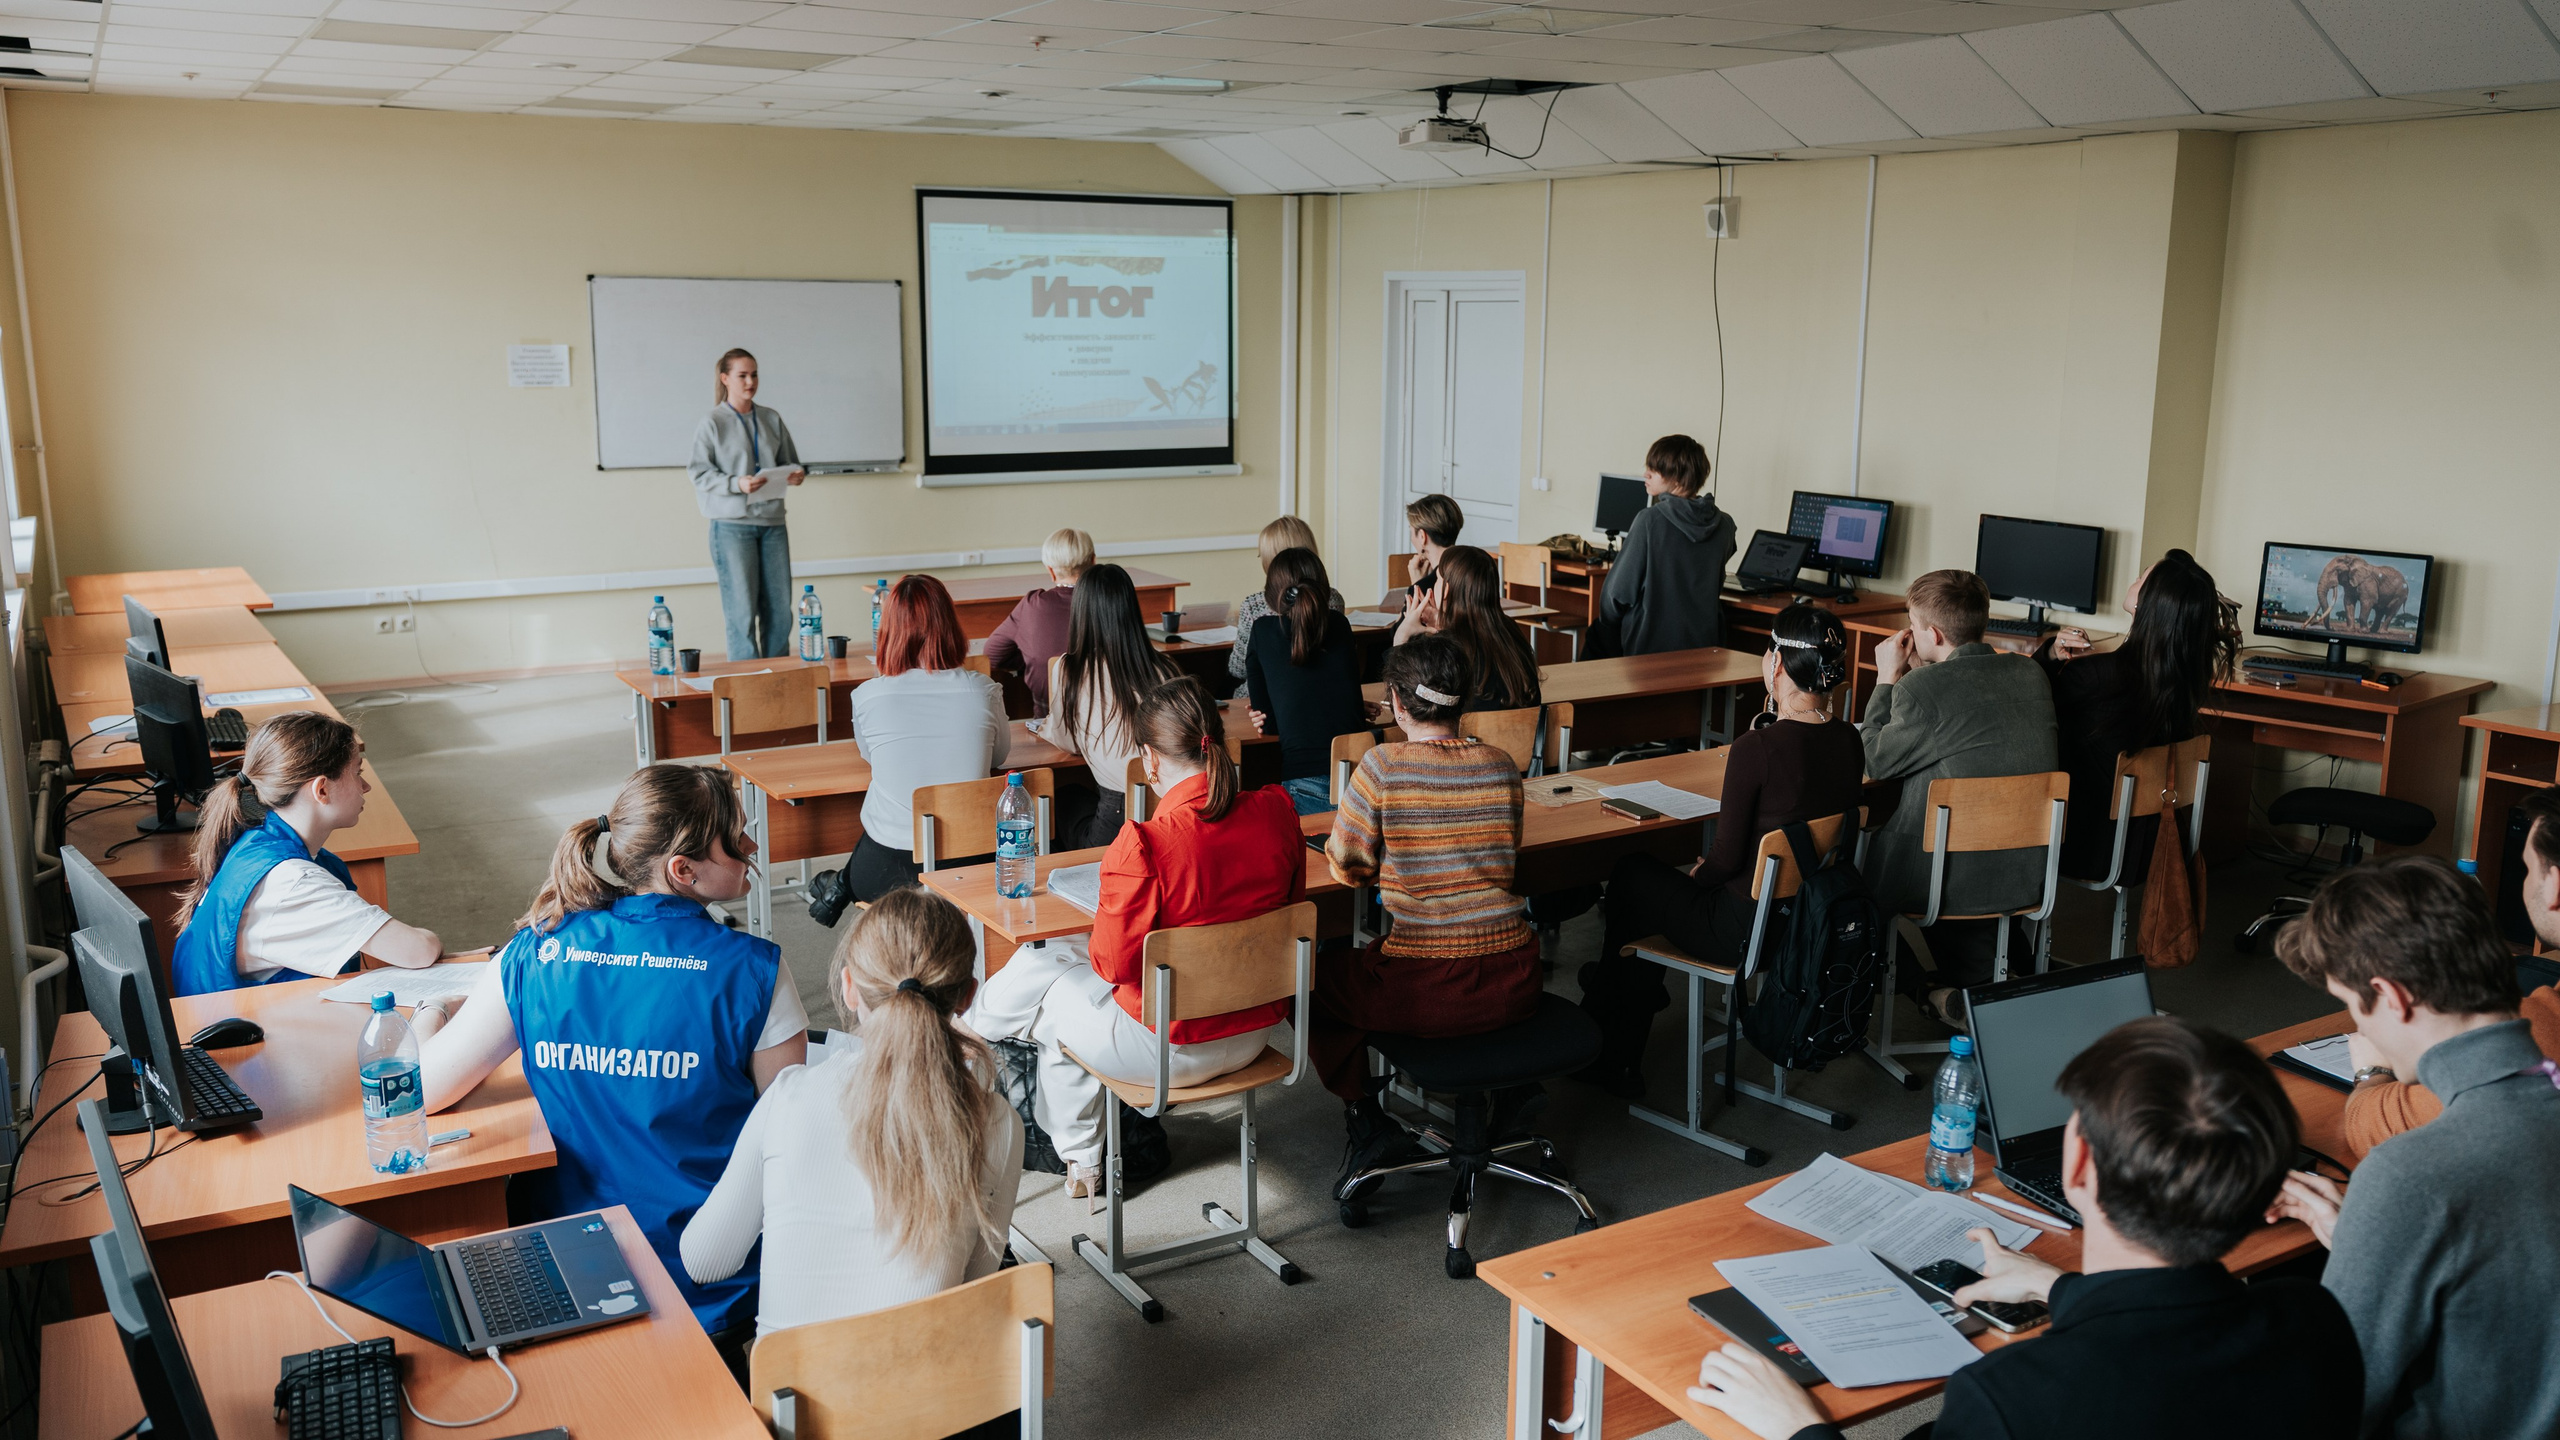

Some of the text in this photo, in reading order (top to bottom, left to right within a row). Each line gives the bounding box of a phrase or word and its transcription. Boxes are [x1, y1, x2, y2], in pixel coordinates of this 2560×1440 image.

[1032, 276, 1153, 317] Итог
[563, 946, 708, 971] Университет Решетнёва
[535, 1041, 699, 1079] ОРГАНИЗАТОР
